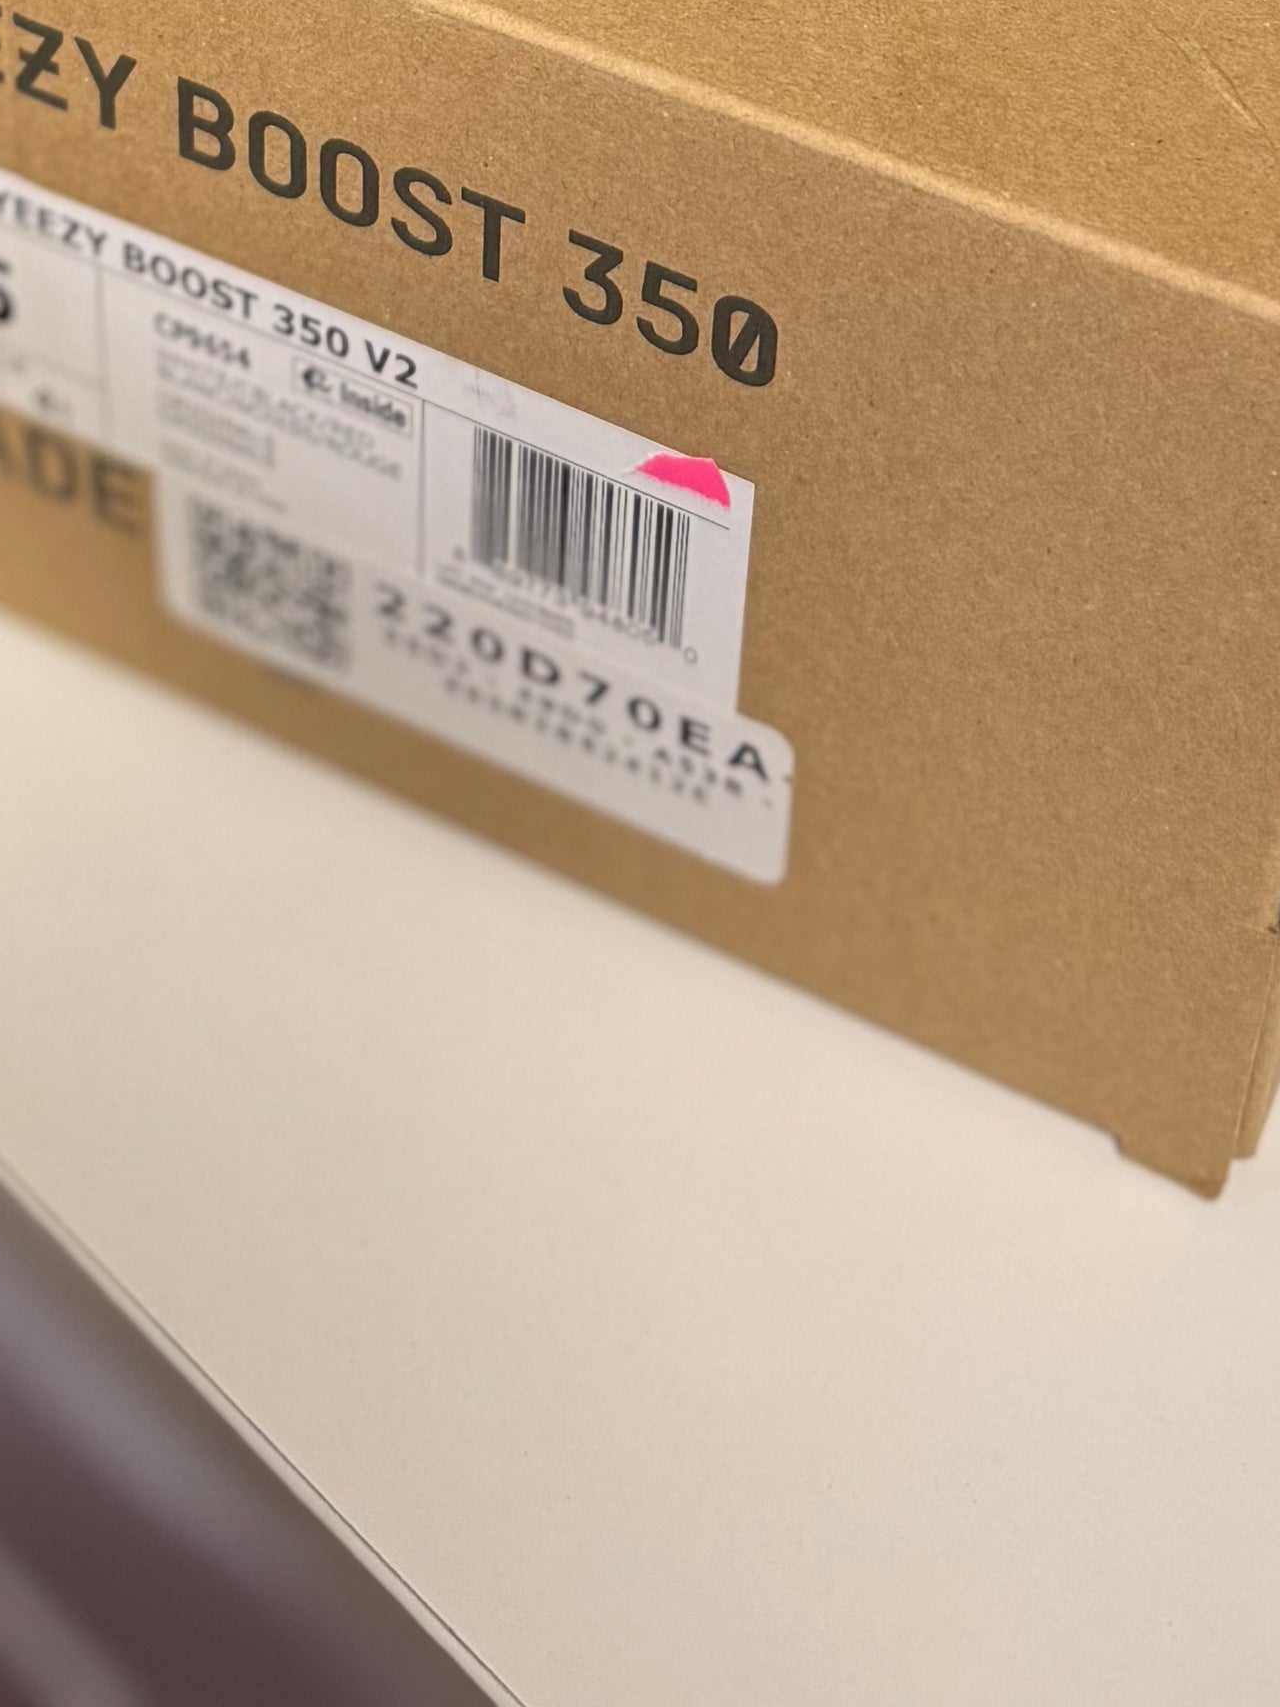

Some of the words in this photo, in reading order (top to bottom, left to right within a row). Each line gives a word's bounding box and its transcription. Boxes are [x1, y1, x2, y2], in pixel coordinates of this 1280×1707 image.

[123, 241, 260, 320] BOOST
[271, 303, 351, 361] 350
[364, 337, 419, 390] V2
[177, 75, 527, 283] BOOST
[562, 229, 778, 387] 350
